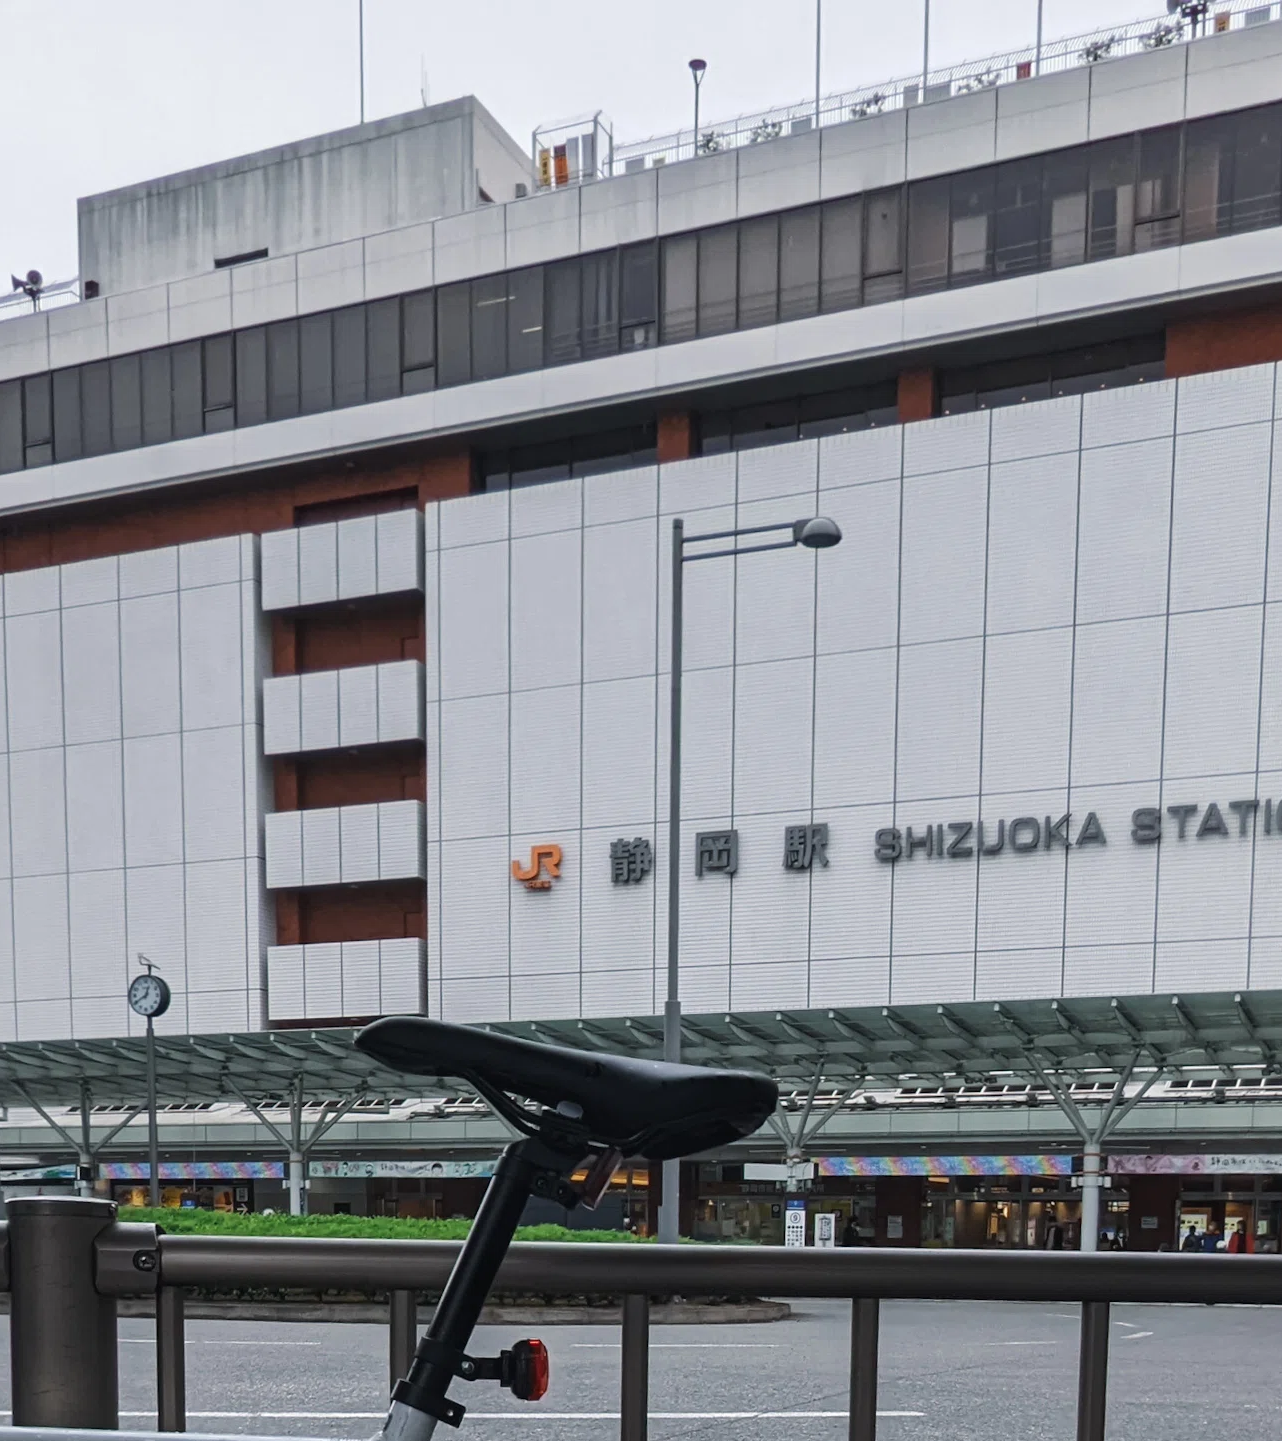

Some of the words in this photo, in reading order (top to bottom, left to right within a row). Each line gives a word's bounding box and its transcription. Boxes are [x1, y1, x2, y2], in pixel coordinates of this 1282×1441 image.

[609, 823, 830, 883] 静岡駅
[874, 811, 1107, 860] SHIZUOKA
[512, 844, 563, 881] JR
